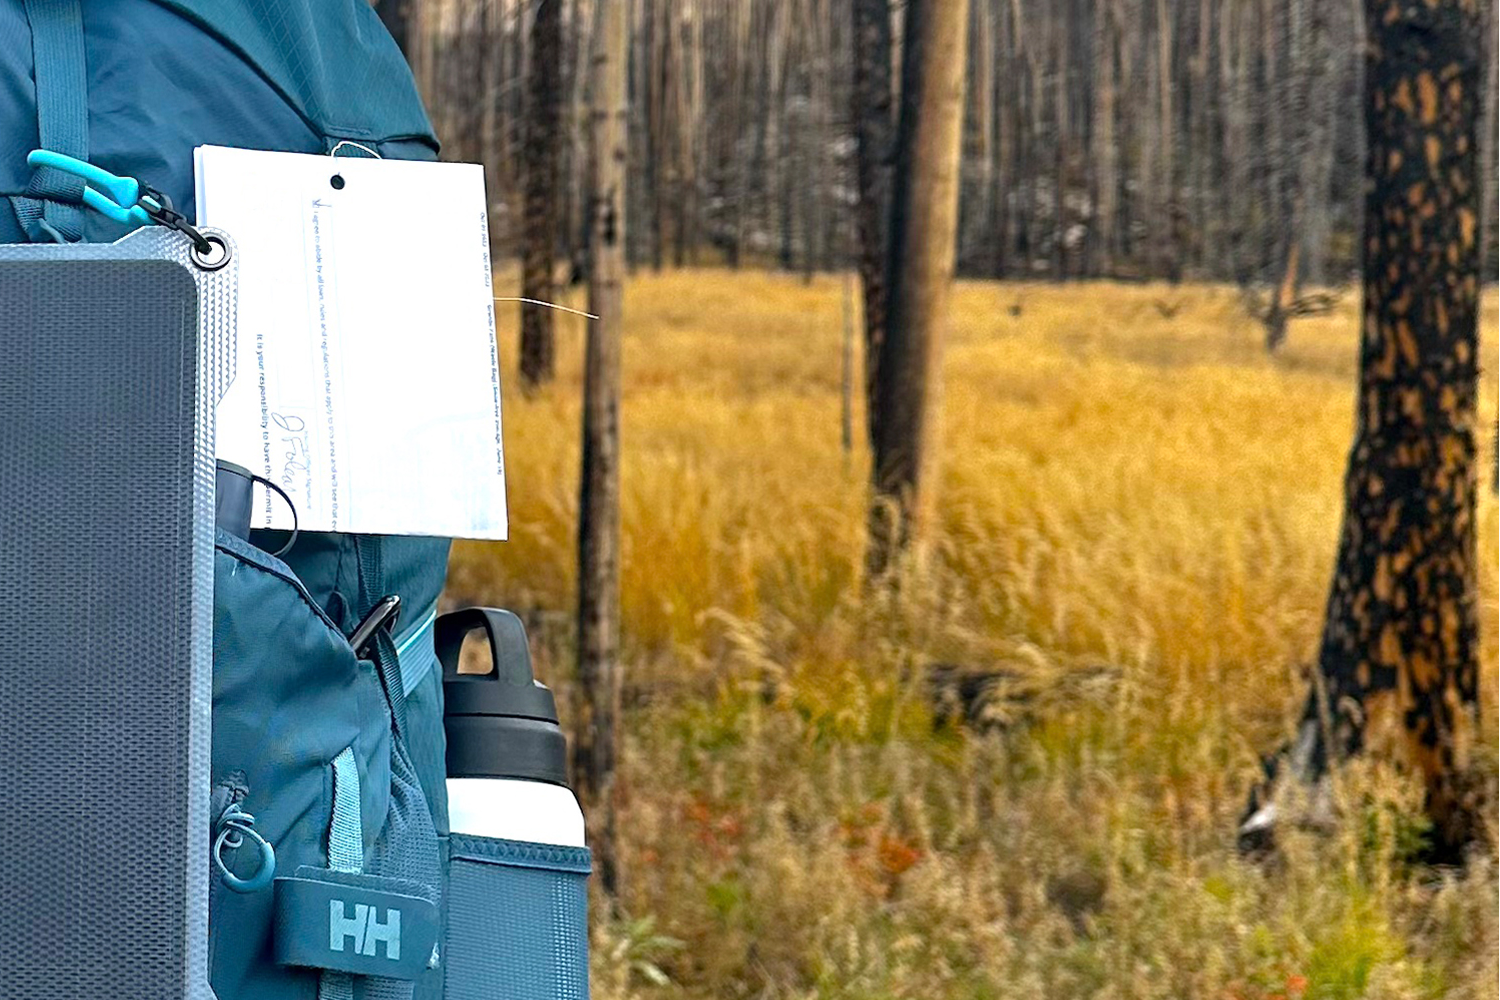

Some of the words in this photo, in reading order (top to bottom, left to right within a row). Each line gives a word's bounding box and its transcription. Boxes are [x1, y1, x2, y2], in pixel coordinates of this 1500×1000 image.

[315, 244, 323, 263] abide
[255, 350, 265, 371] your
[320, 338, 330, 378] regulations
[258, 372, 270, 430] responsibility
[325, 395, 334, 415] apply
[262, 431, 270, 440] to
[263, 442, 271, 463] have
[330, 458, 338, 473] and
[265, 484, 273, 514] ermit
[265, 515, 273, 525] in
[331, 502, 339, 519] that
[329, 899, 401, 960] HH
